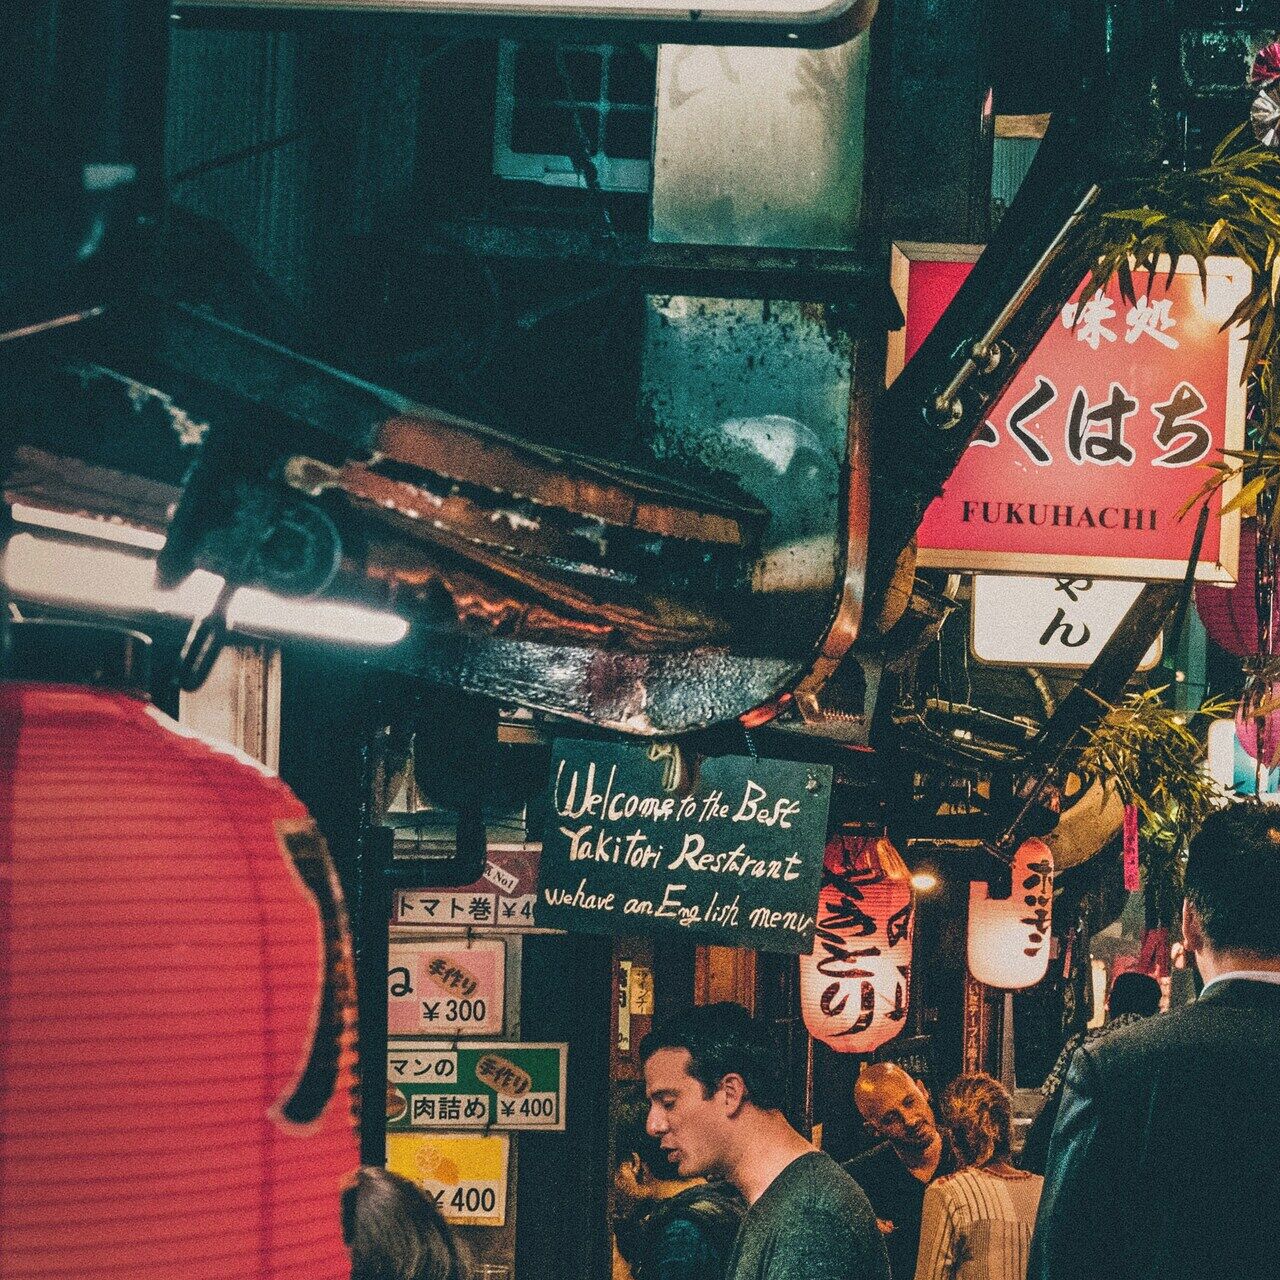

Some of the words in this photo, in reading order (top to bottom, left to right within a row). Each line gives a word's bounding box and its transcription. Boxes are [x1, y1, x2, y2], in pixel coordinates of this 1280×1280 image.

[962, 500, 1158, 531] FUKUHACHI
[555, 759, 673, 822] Welcome
[676, 793, 698, 822] to
[698, 790, 729, 823] the
[400, 896, 492, 921] トマト巻
[422, 999, 486, 1021] ¥300
[413, 1096, 487, 1120] 肉詰め
[501, 1098, 554, 1118] ¥400
